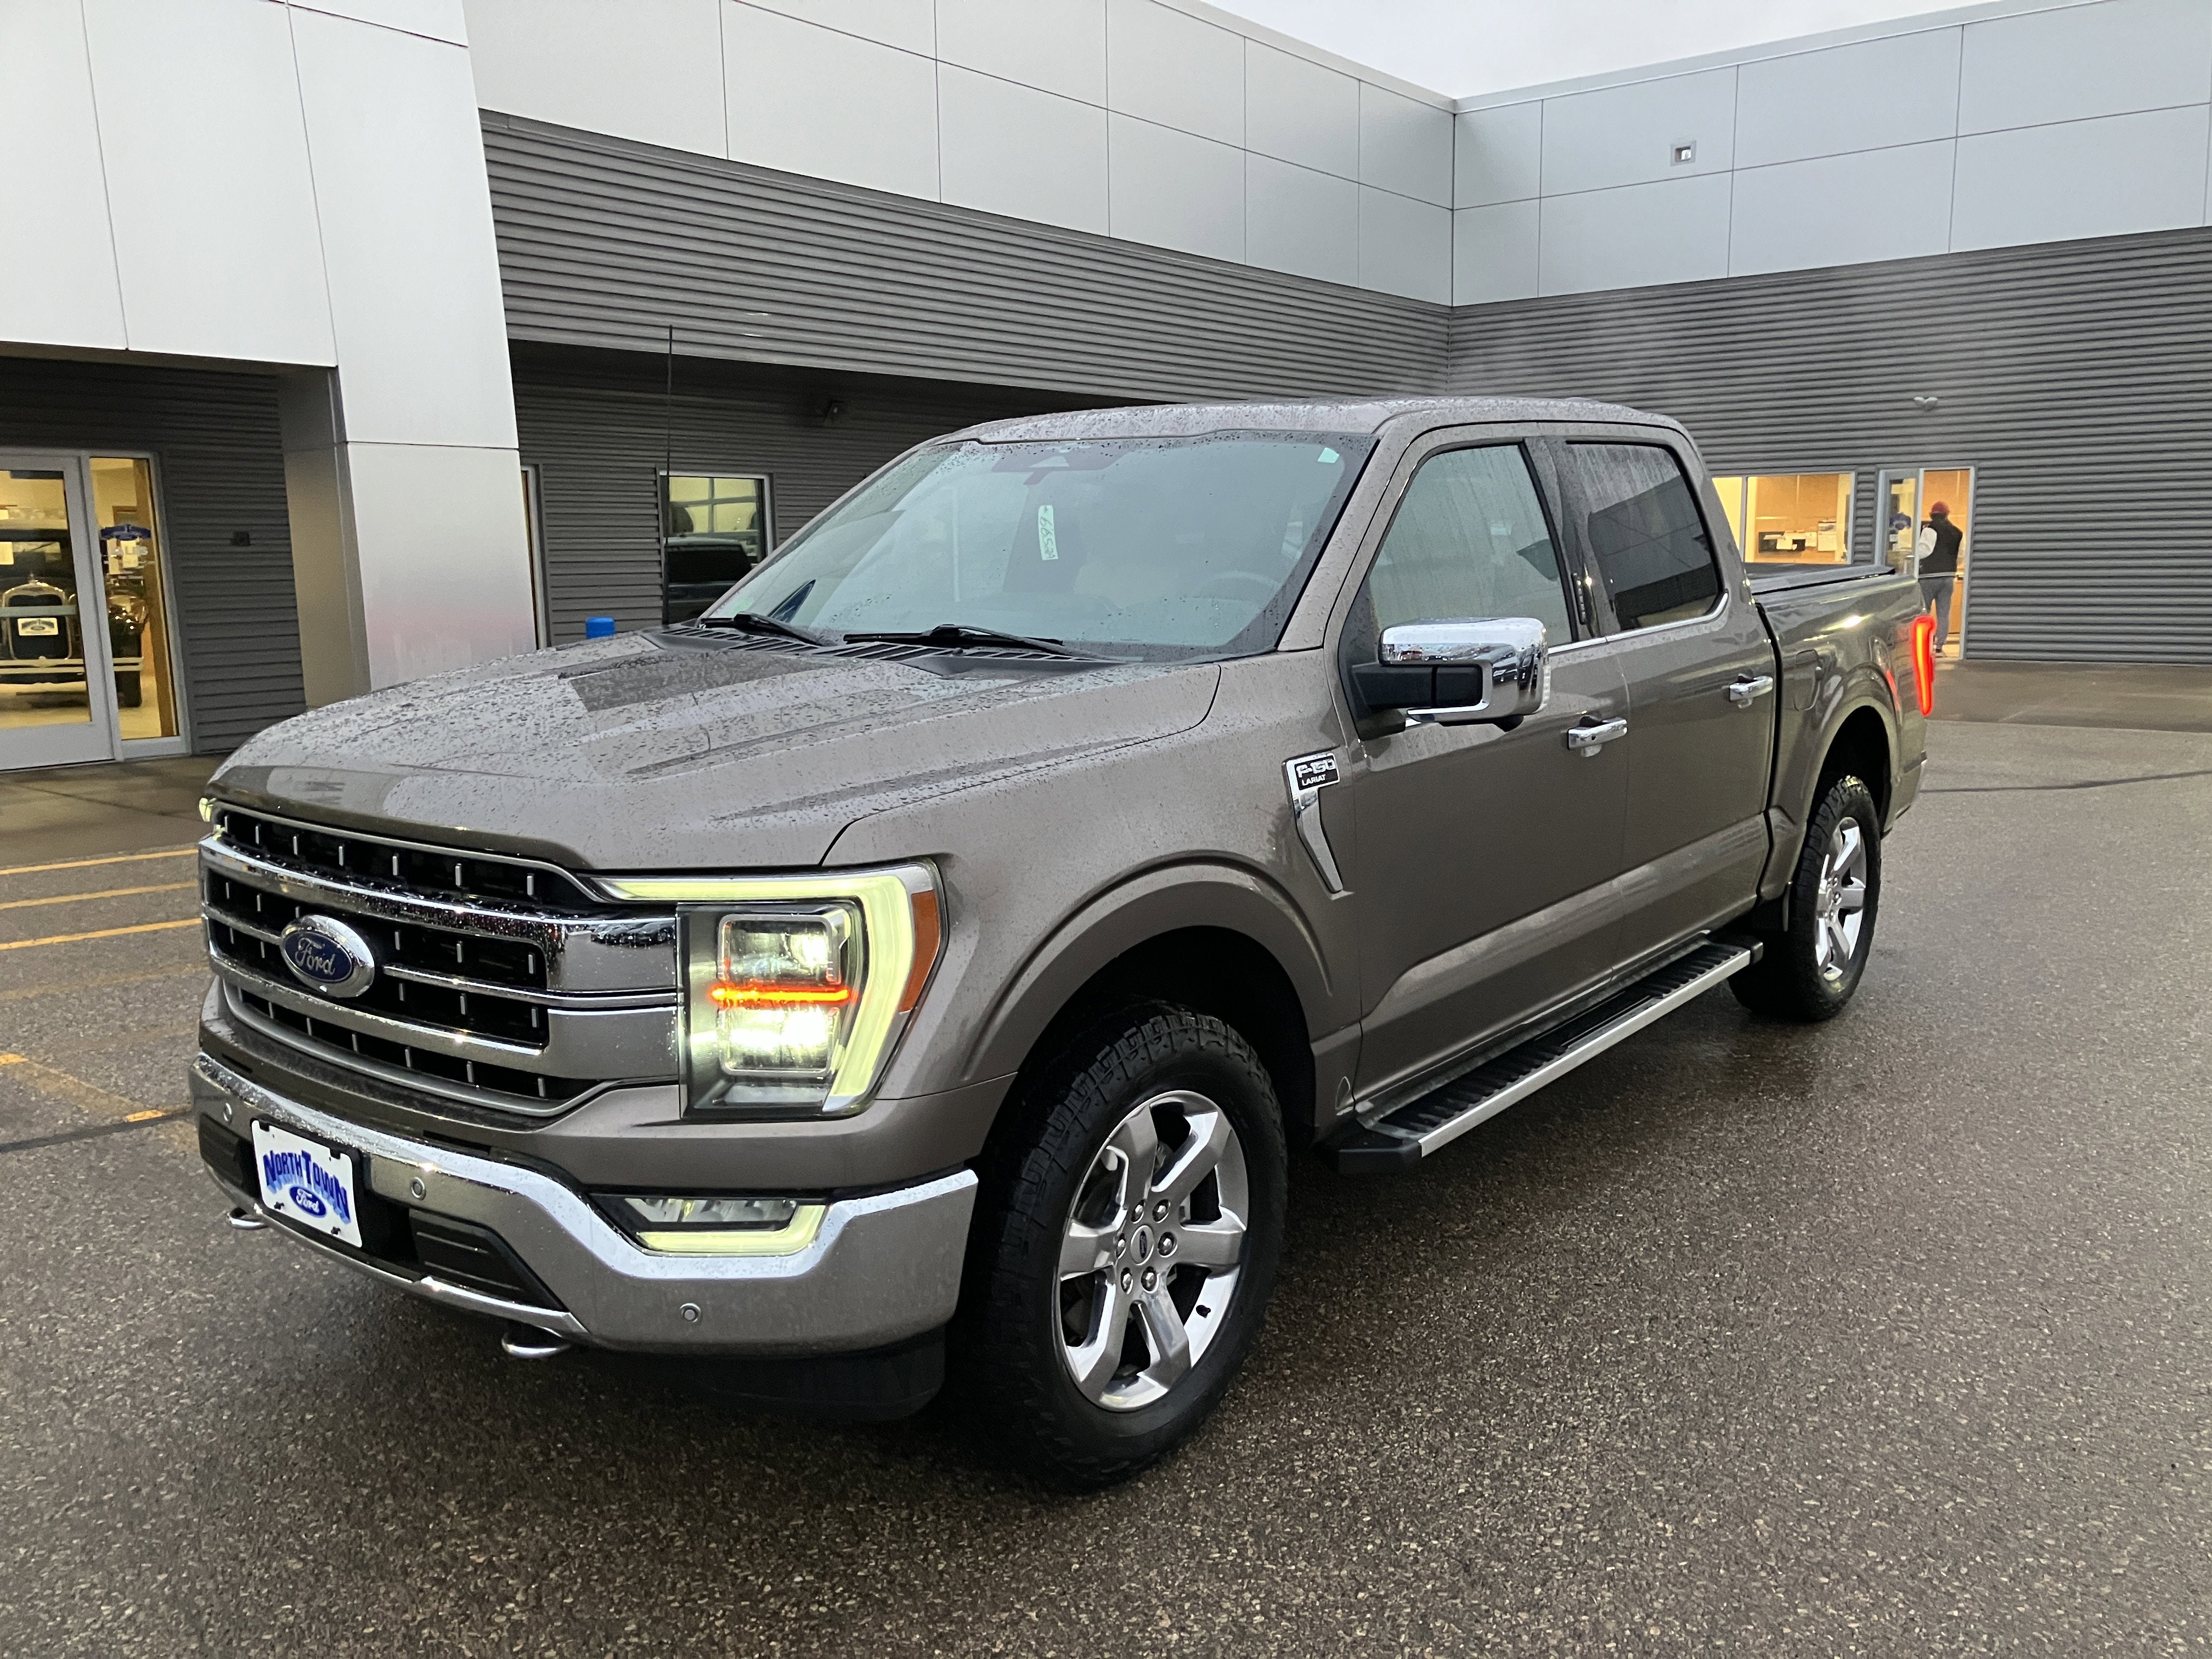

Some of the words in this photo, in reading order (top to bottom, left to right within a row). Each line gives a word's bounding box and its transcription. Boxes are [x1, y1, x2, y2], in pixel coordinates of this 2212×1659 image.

[1301, 774, 1326, 786] LARIAT
[295, 937, 336, 975] Ford
[296, 1188, 319, 1214] Ford
